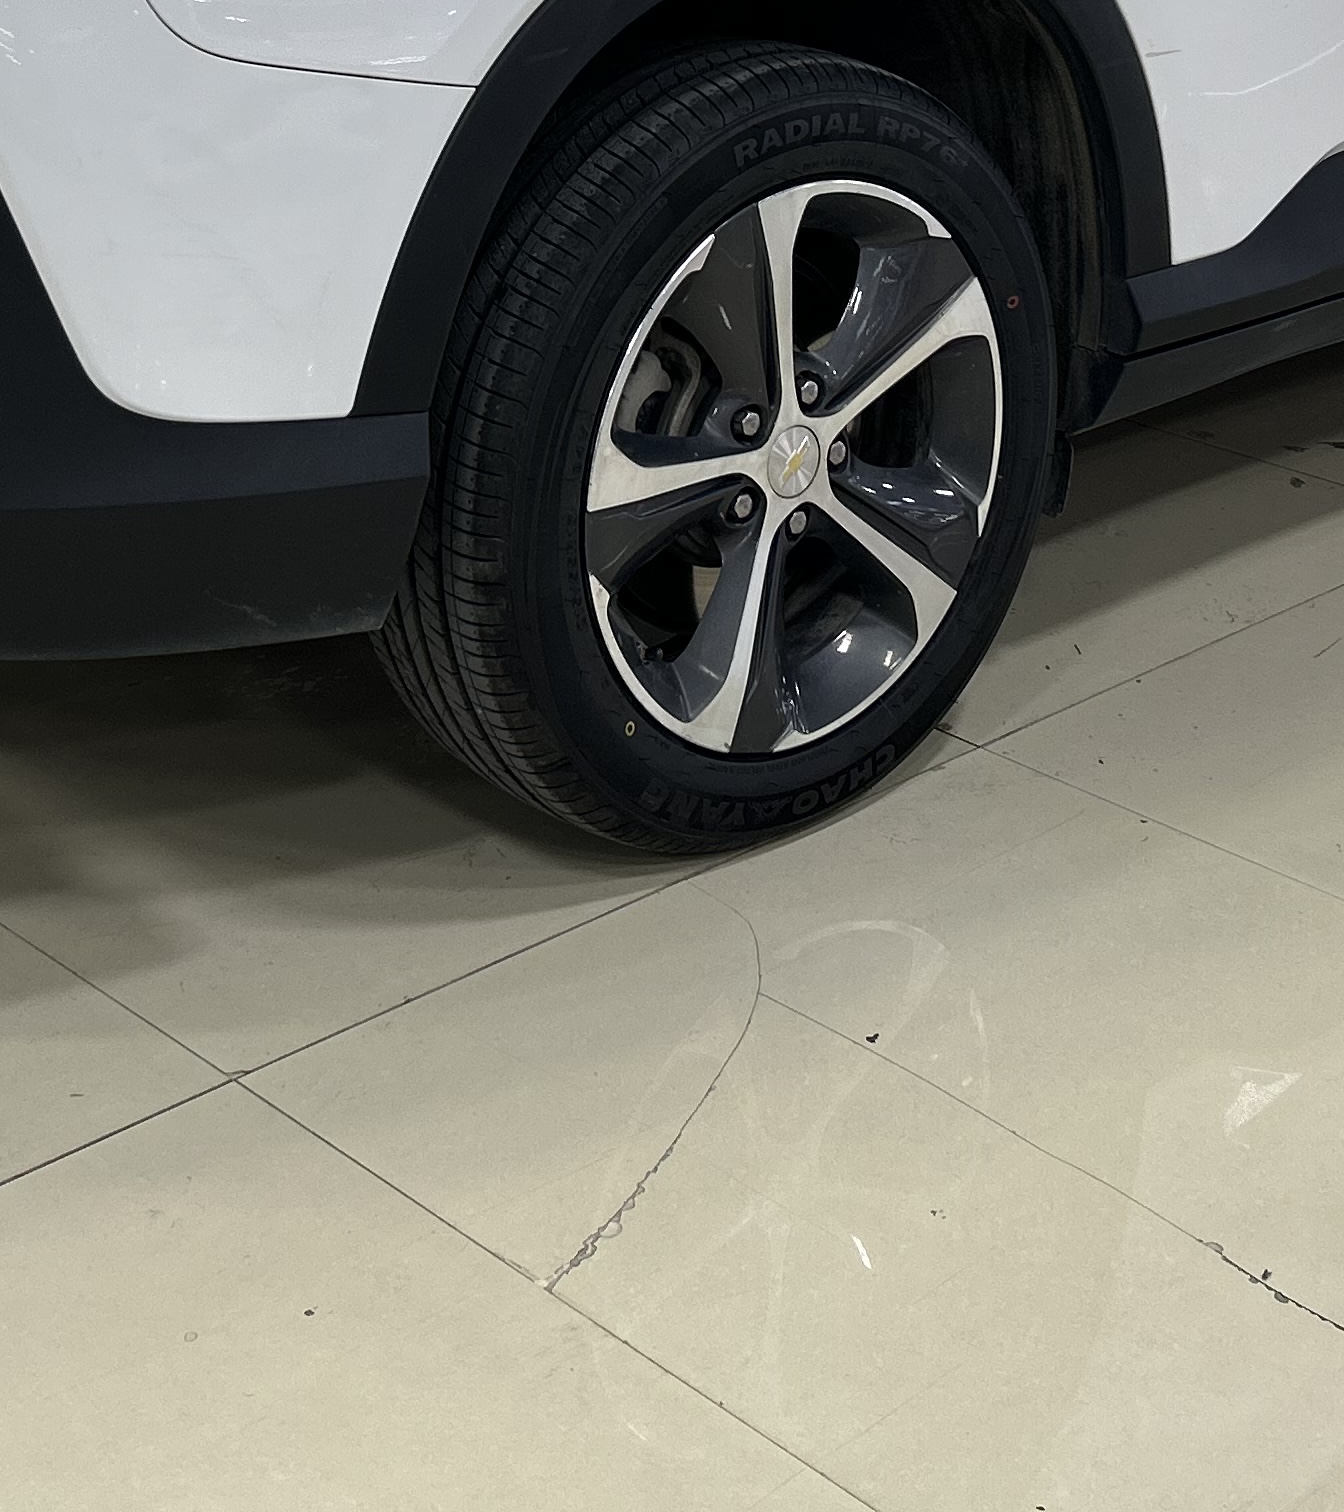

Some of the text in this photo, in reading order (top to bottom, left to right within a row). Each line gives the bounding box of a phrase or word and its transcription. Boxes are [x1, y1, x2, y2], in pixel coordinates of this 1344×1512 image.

[733, 112, 866, 168] RADIAL
[640, 778, 747, 826] YANG
[791, 743, 896, 815] CHAO
